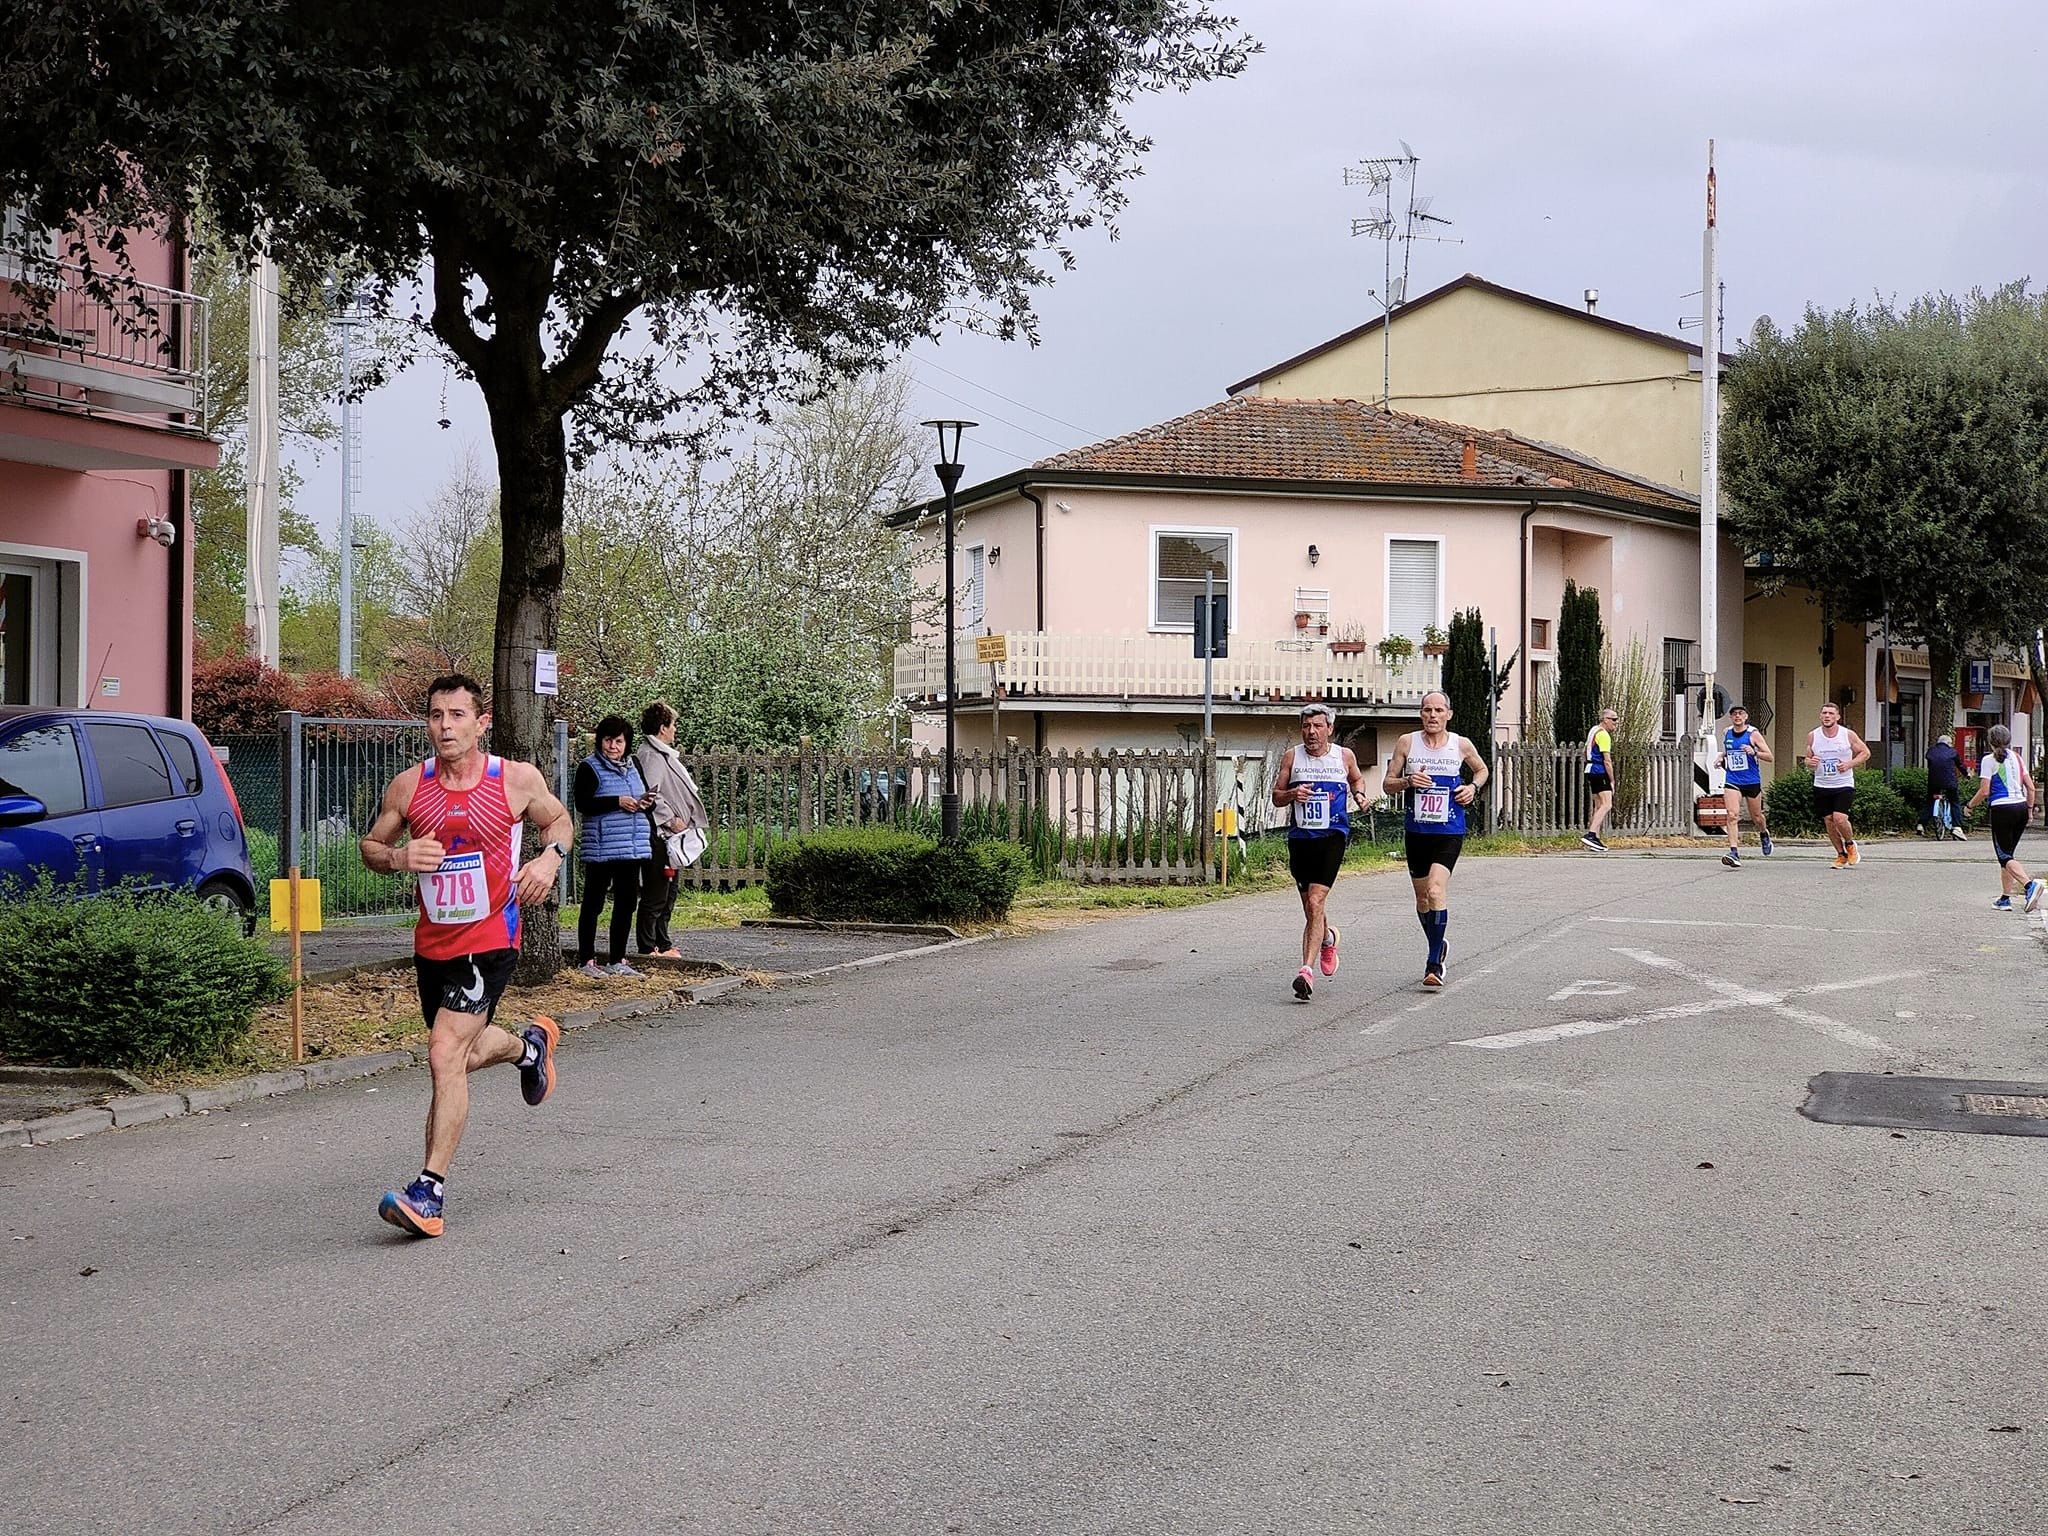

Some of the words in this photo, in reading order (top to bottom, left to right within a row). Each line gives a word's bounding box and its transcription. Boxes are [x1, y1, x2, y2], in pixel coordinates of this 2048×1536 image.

[1408, 757, 1460, 766] QUADRILATERO
[1731, 755, 1744, 766] 155
[1294, 767, 1344, 775] QUADRILATERO
[1823, 763, 1836, 773] 125
[1421, 795, 1443, 812] 202
[1302, 801, 1322, 820] 139
[431, 872, 475, 906] 278
